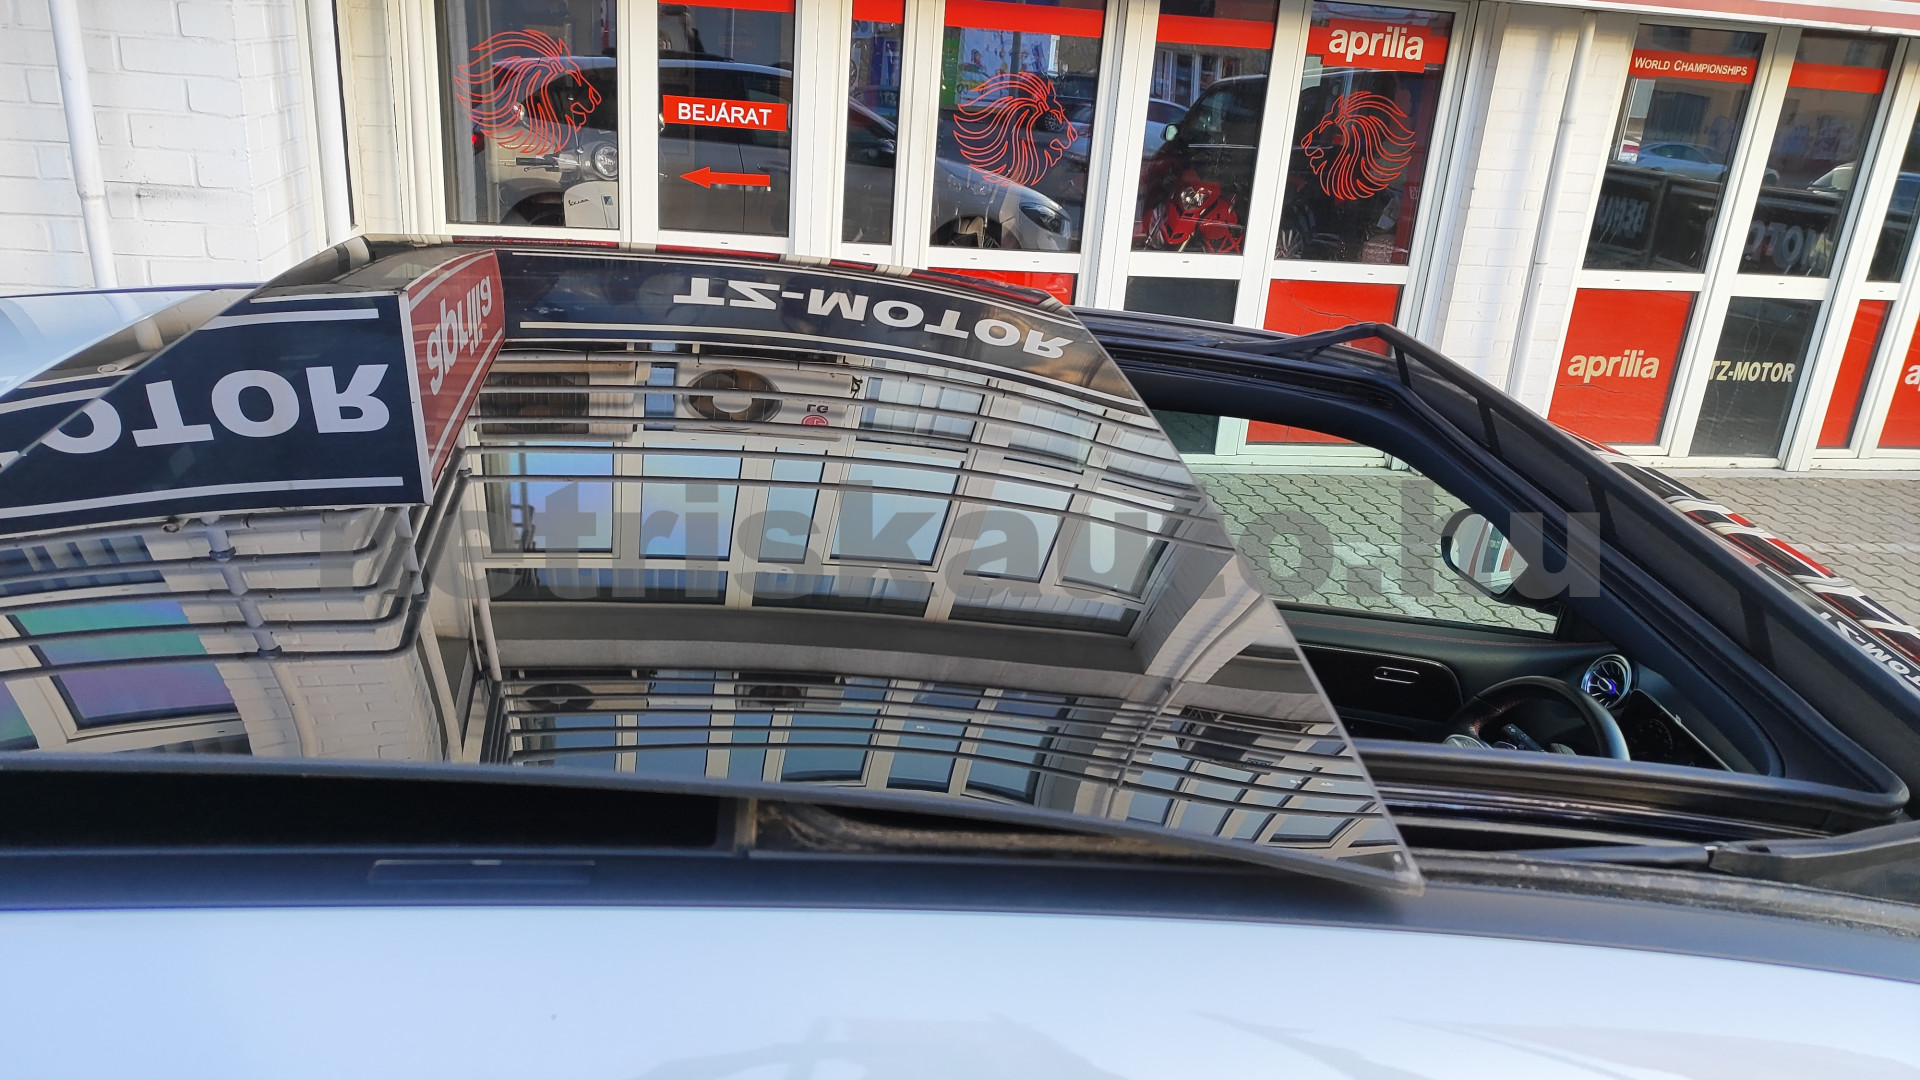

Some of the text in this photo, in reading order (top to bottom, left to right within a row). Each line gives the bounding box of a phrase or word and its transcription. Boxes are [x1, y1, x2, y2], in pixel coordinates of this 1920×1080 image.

[1328, 26, 1424, 62] aprilia
[1634, 57, 1748, 76] WORLD CHAMPIONSHIPS
[678, 102, 772, 126] BEJÁRAT
[1567, 349, 1660, 384] aprilia
[1709, 360, 1796, 383] TZ-MOTOR
